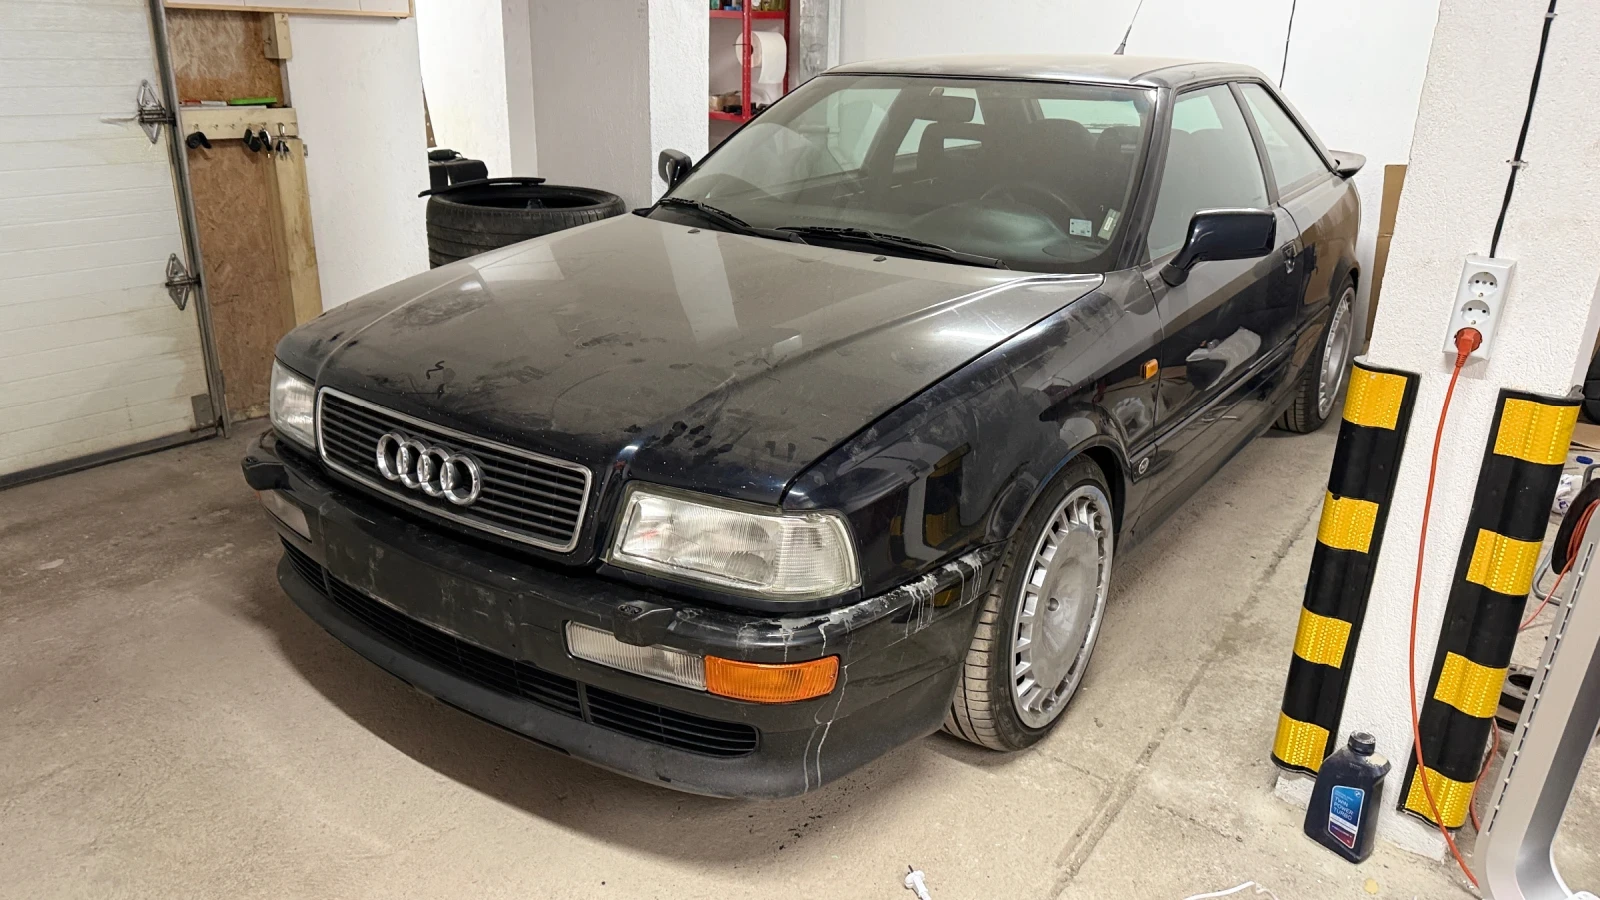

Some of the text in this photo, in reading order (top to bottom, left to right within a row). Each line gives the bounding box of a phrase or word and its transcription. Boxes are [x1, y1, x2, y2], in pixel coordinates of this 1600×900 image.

[1335, 796, 1349, 807] TWIN
[1333, 801, 1354, 816] POWER
[1333, 807, 1353, 820] TURBO
